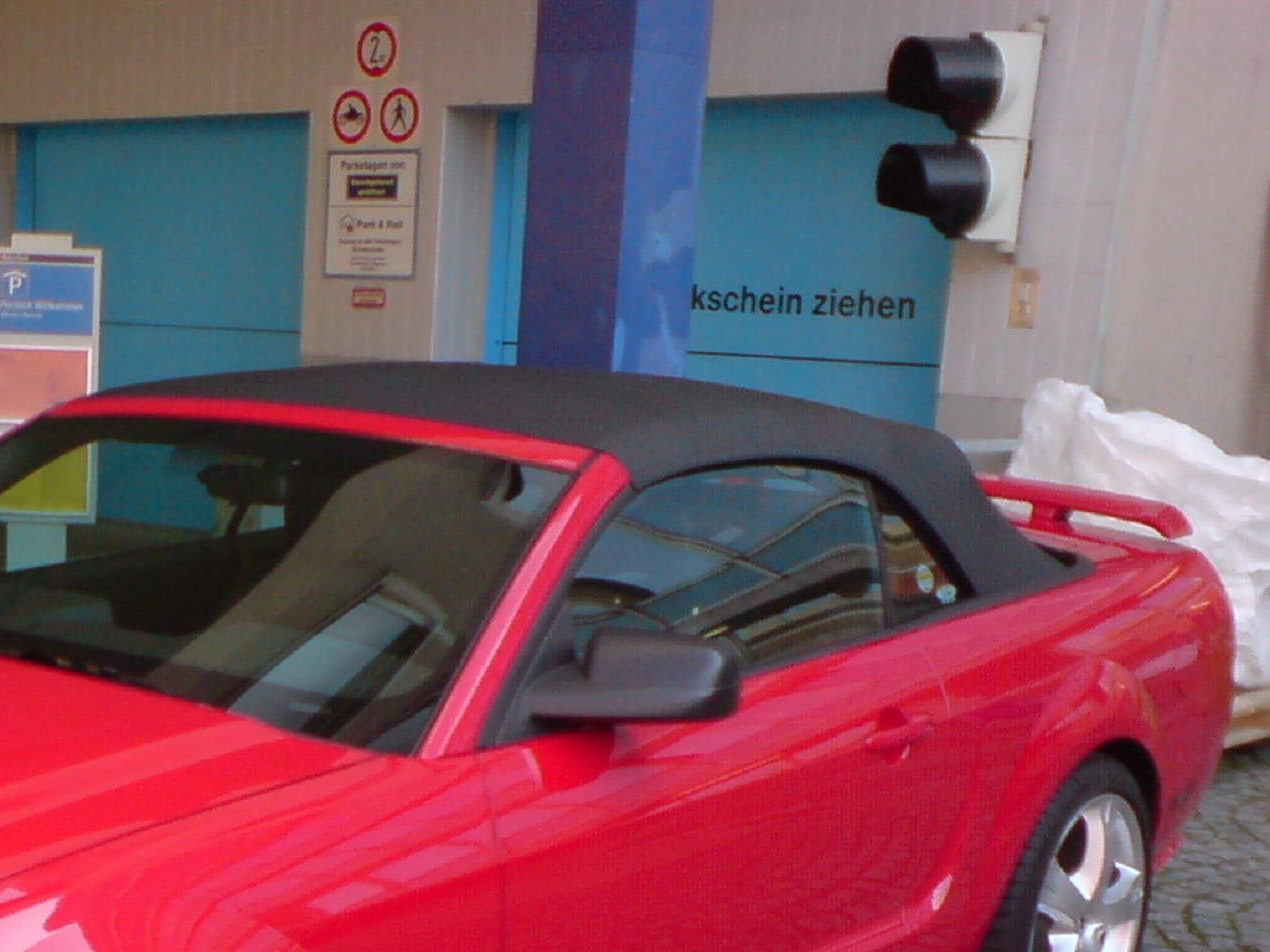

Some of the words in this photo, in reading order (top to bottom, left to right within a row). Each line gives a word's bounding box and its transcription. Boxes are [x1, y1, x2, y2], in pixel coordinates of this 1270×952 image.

[356, 219, 376, 229] Park
[9, 276, 22, 295] P
[691, 284, 802, 315] kschein
[811, 288, 916, 319] ziehen
